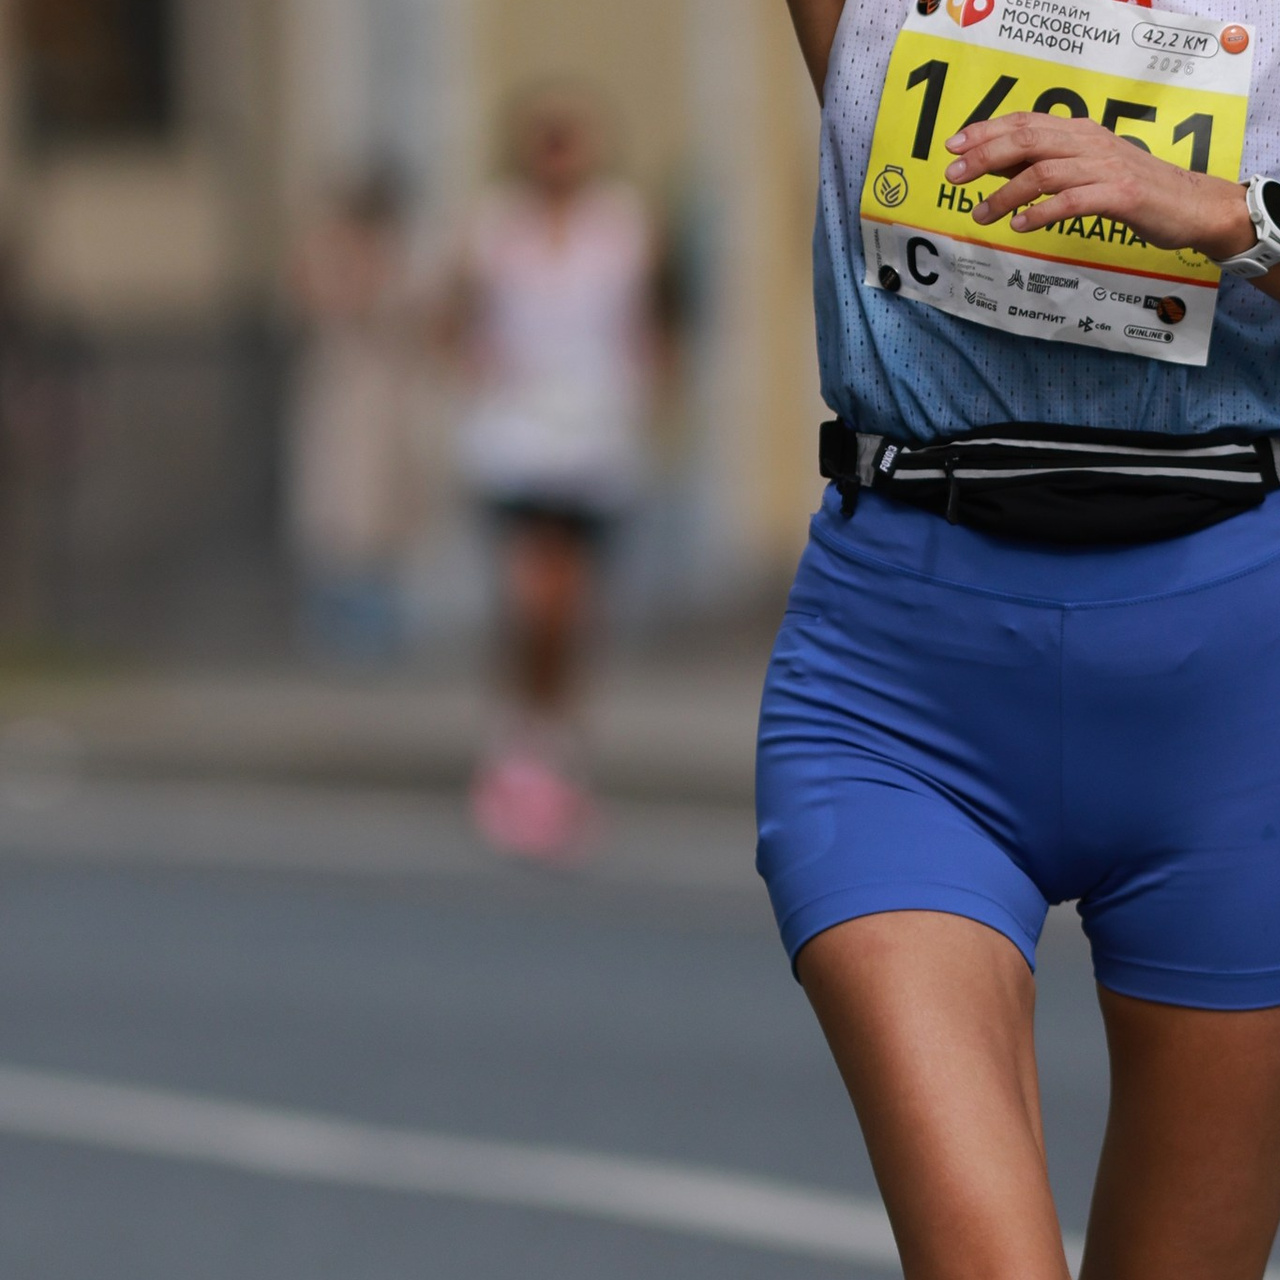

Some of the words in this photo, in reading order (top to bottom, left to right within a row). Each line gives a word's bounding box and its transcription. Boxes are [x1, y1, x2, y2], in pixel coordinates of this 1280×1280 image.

[1002, 7, 1121, 46] МОСКОВСКИЙ
[998, 24, 1084, 55] МАРАФОН
[1142, 29, 1179, 48] 42,2
[1182, 35, 1208, 52] КМ
[1146, 55, 1195, 76] 2026
[1026, 282, 1051, 295] СПОРТ
[1027, 272, 1079, 290] МОСКОВСКИЙ
[975, 299, 997, 312] BRICS
[1109, 291, 1142, 305] СБЕР
[1018, 307, 1066, 325] магнит
[1094, 322, 1112, 332] сбп
[1127, 327, 1163, 340] WINLINE
